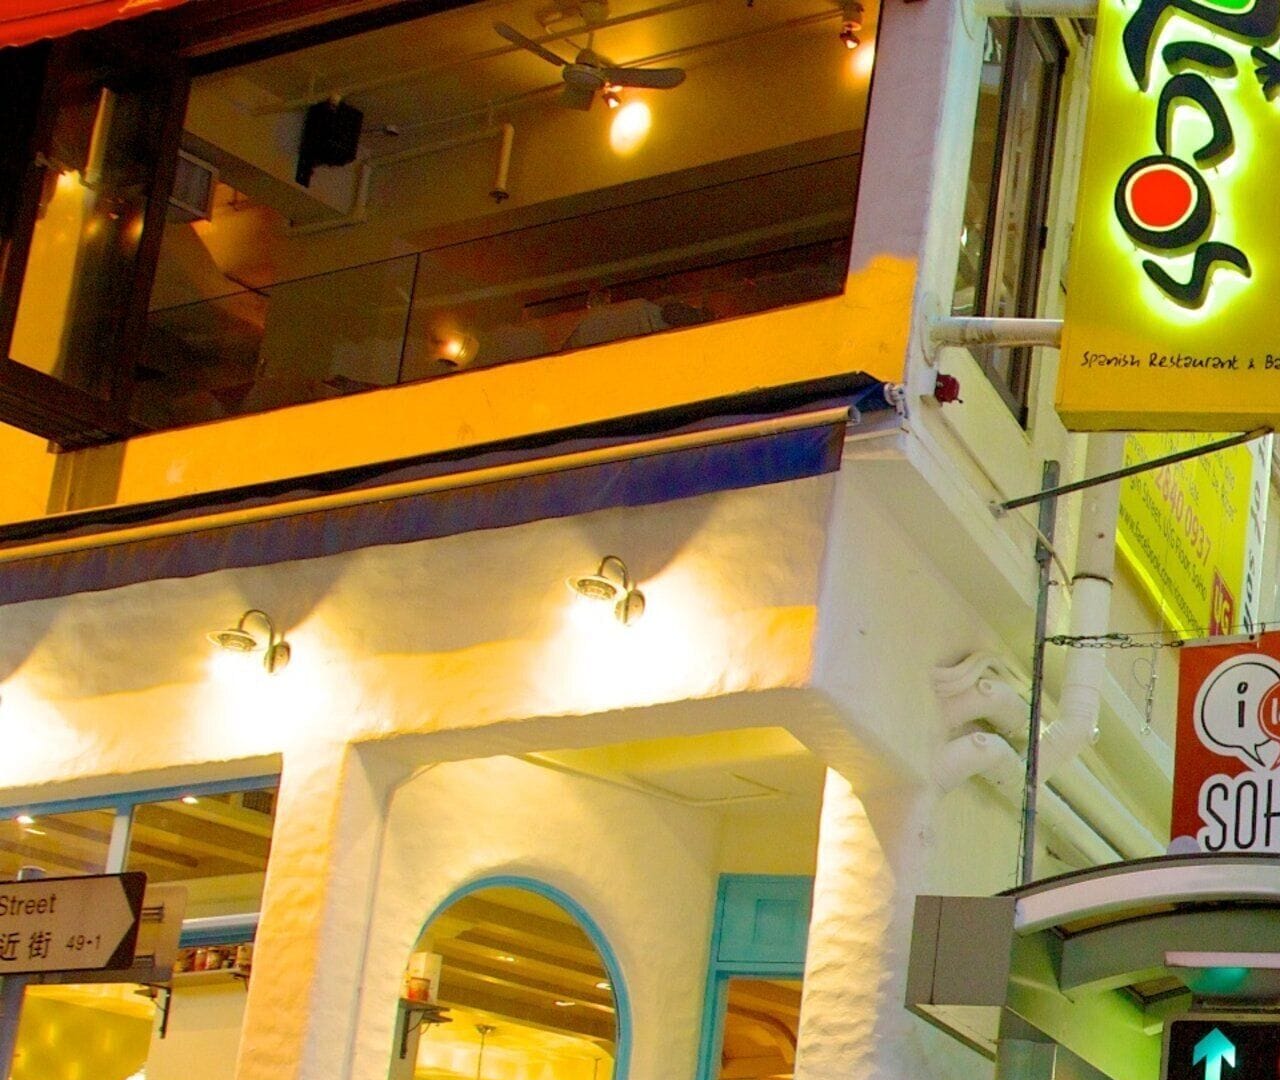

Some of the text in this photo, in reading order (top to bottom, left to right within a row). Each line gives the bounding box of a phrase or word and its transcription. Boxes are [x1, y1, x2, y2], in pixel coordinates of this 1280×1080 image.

[1081, 351, 1140, 368] Spanish
[1149, 352, 1239, 370] Restaurant
[1183, 506, 1212, 567] 0937
[0, 893, 57, 916] Street
